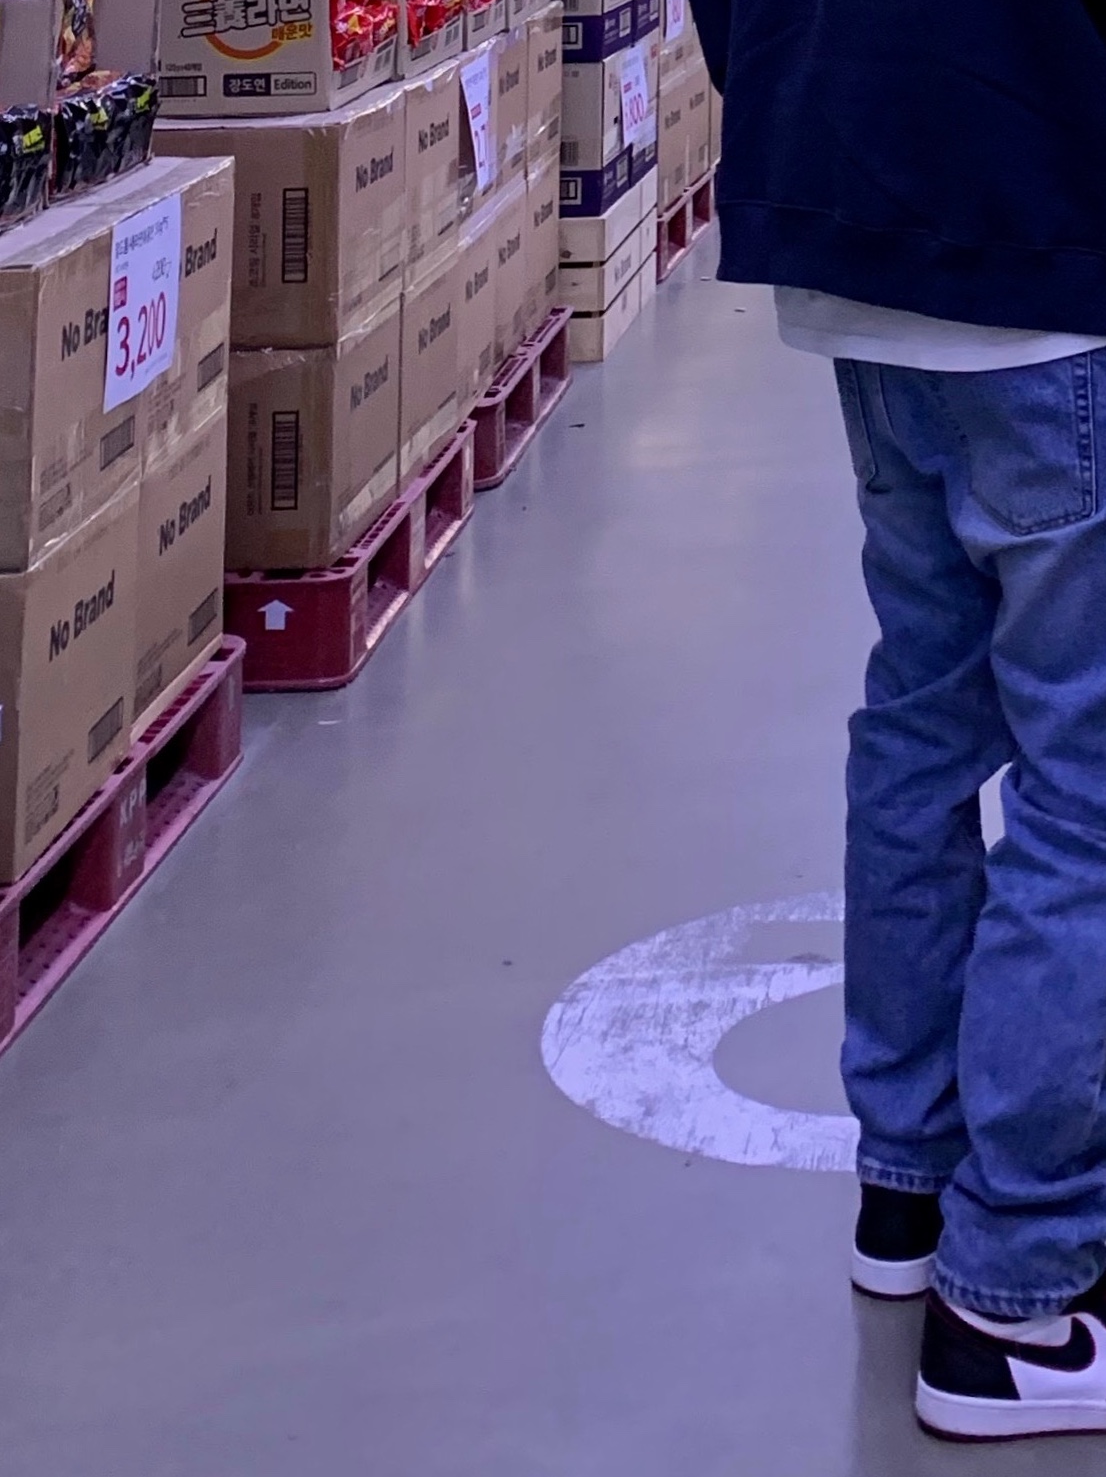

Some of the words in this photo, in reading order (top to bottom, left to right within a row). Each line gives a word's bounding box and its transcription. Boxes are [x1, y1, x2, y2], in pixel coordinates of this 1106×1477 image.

[271, 23, 313, 41] 매운맛
[228, 77, 267, 93] 장도연
[273, 76, 312, 91] Edition
[356, 162, 369, 193] No
[370, 146, 394, 186] Brand
[184, 227, 217, 277] Brand
[62, 322, 81, 362] No
[84, 306, 108, 346] Bra
[115, 291, 167, 381] 3,200
[350, 382, 363, 413] No
[363, 354, 389, 400] Brand
[159, 522, 176, 557] No
[178, 474, 212, 537] Brand
[50, 618, 70, 663] No
[73, 569, 116, 639] Brand
